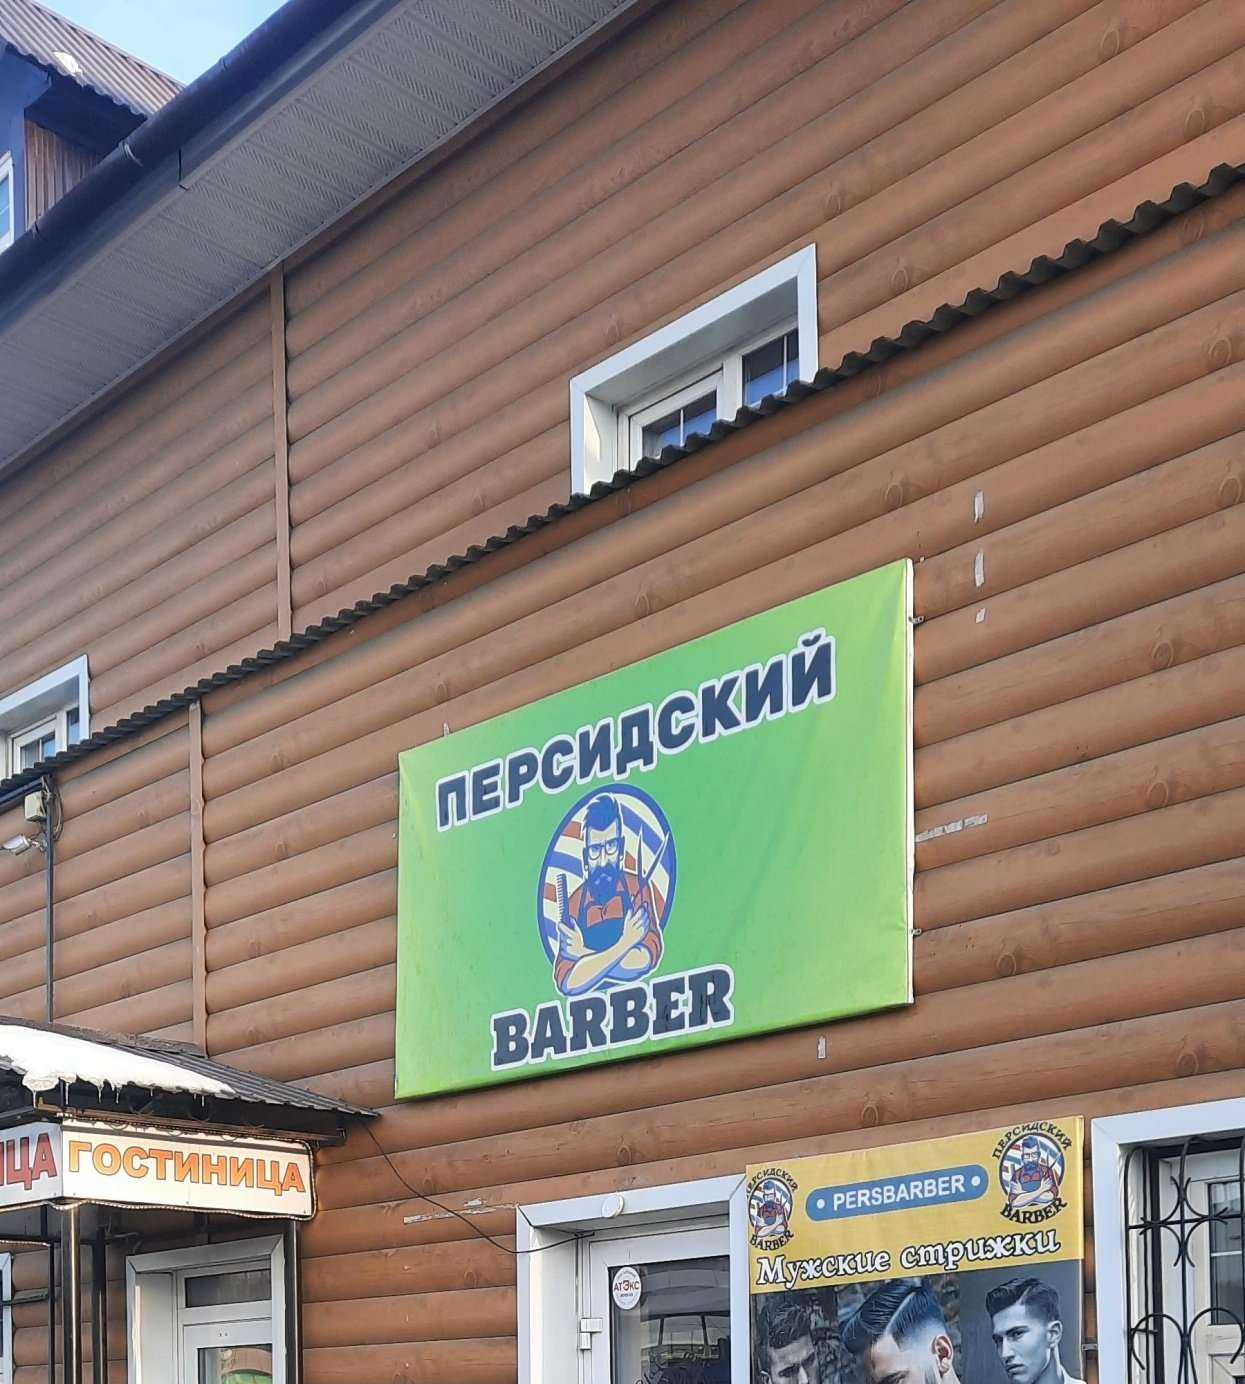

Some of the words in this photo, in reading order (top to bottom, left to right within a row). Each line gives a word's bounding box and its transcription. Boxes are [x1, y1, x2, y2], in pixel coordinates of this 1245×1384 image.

[437, 629, 834, 828] ПЕРСИДСКИЙ
[491, 966, 734, 1069] BARBER
[68, 1140, 306, 1197] ГОСТИНИЦА
[833, 1174, 966, 1212] PERSBARBER
[1000, 1197, 1068, 1224] BARBER
[750, 1229, 794, 1251] BARBER
[756, 1250, 891, 1290] Мужские
[900, 1229, 1061, 1271] стрижки
[614, 1280, 640, 1292] АТЭКС
